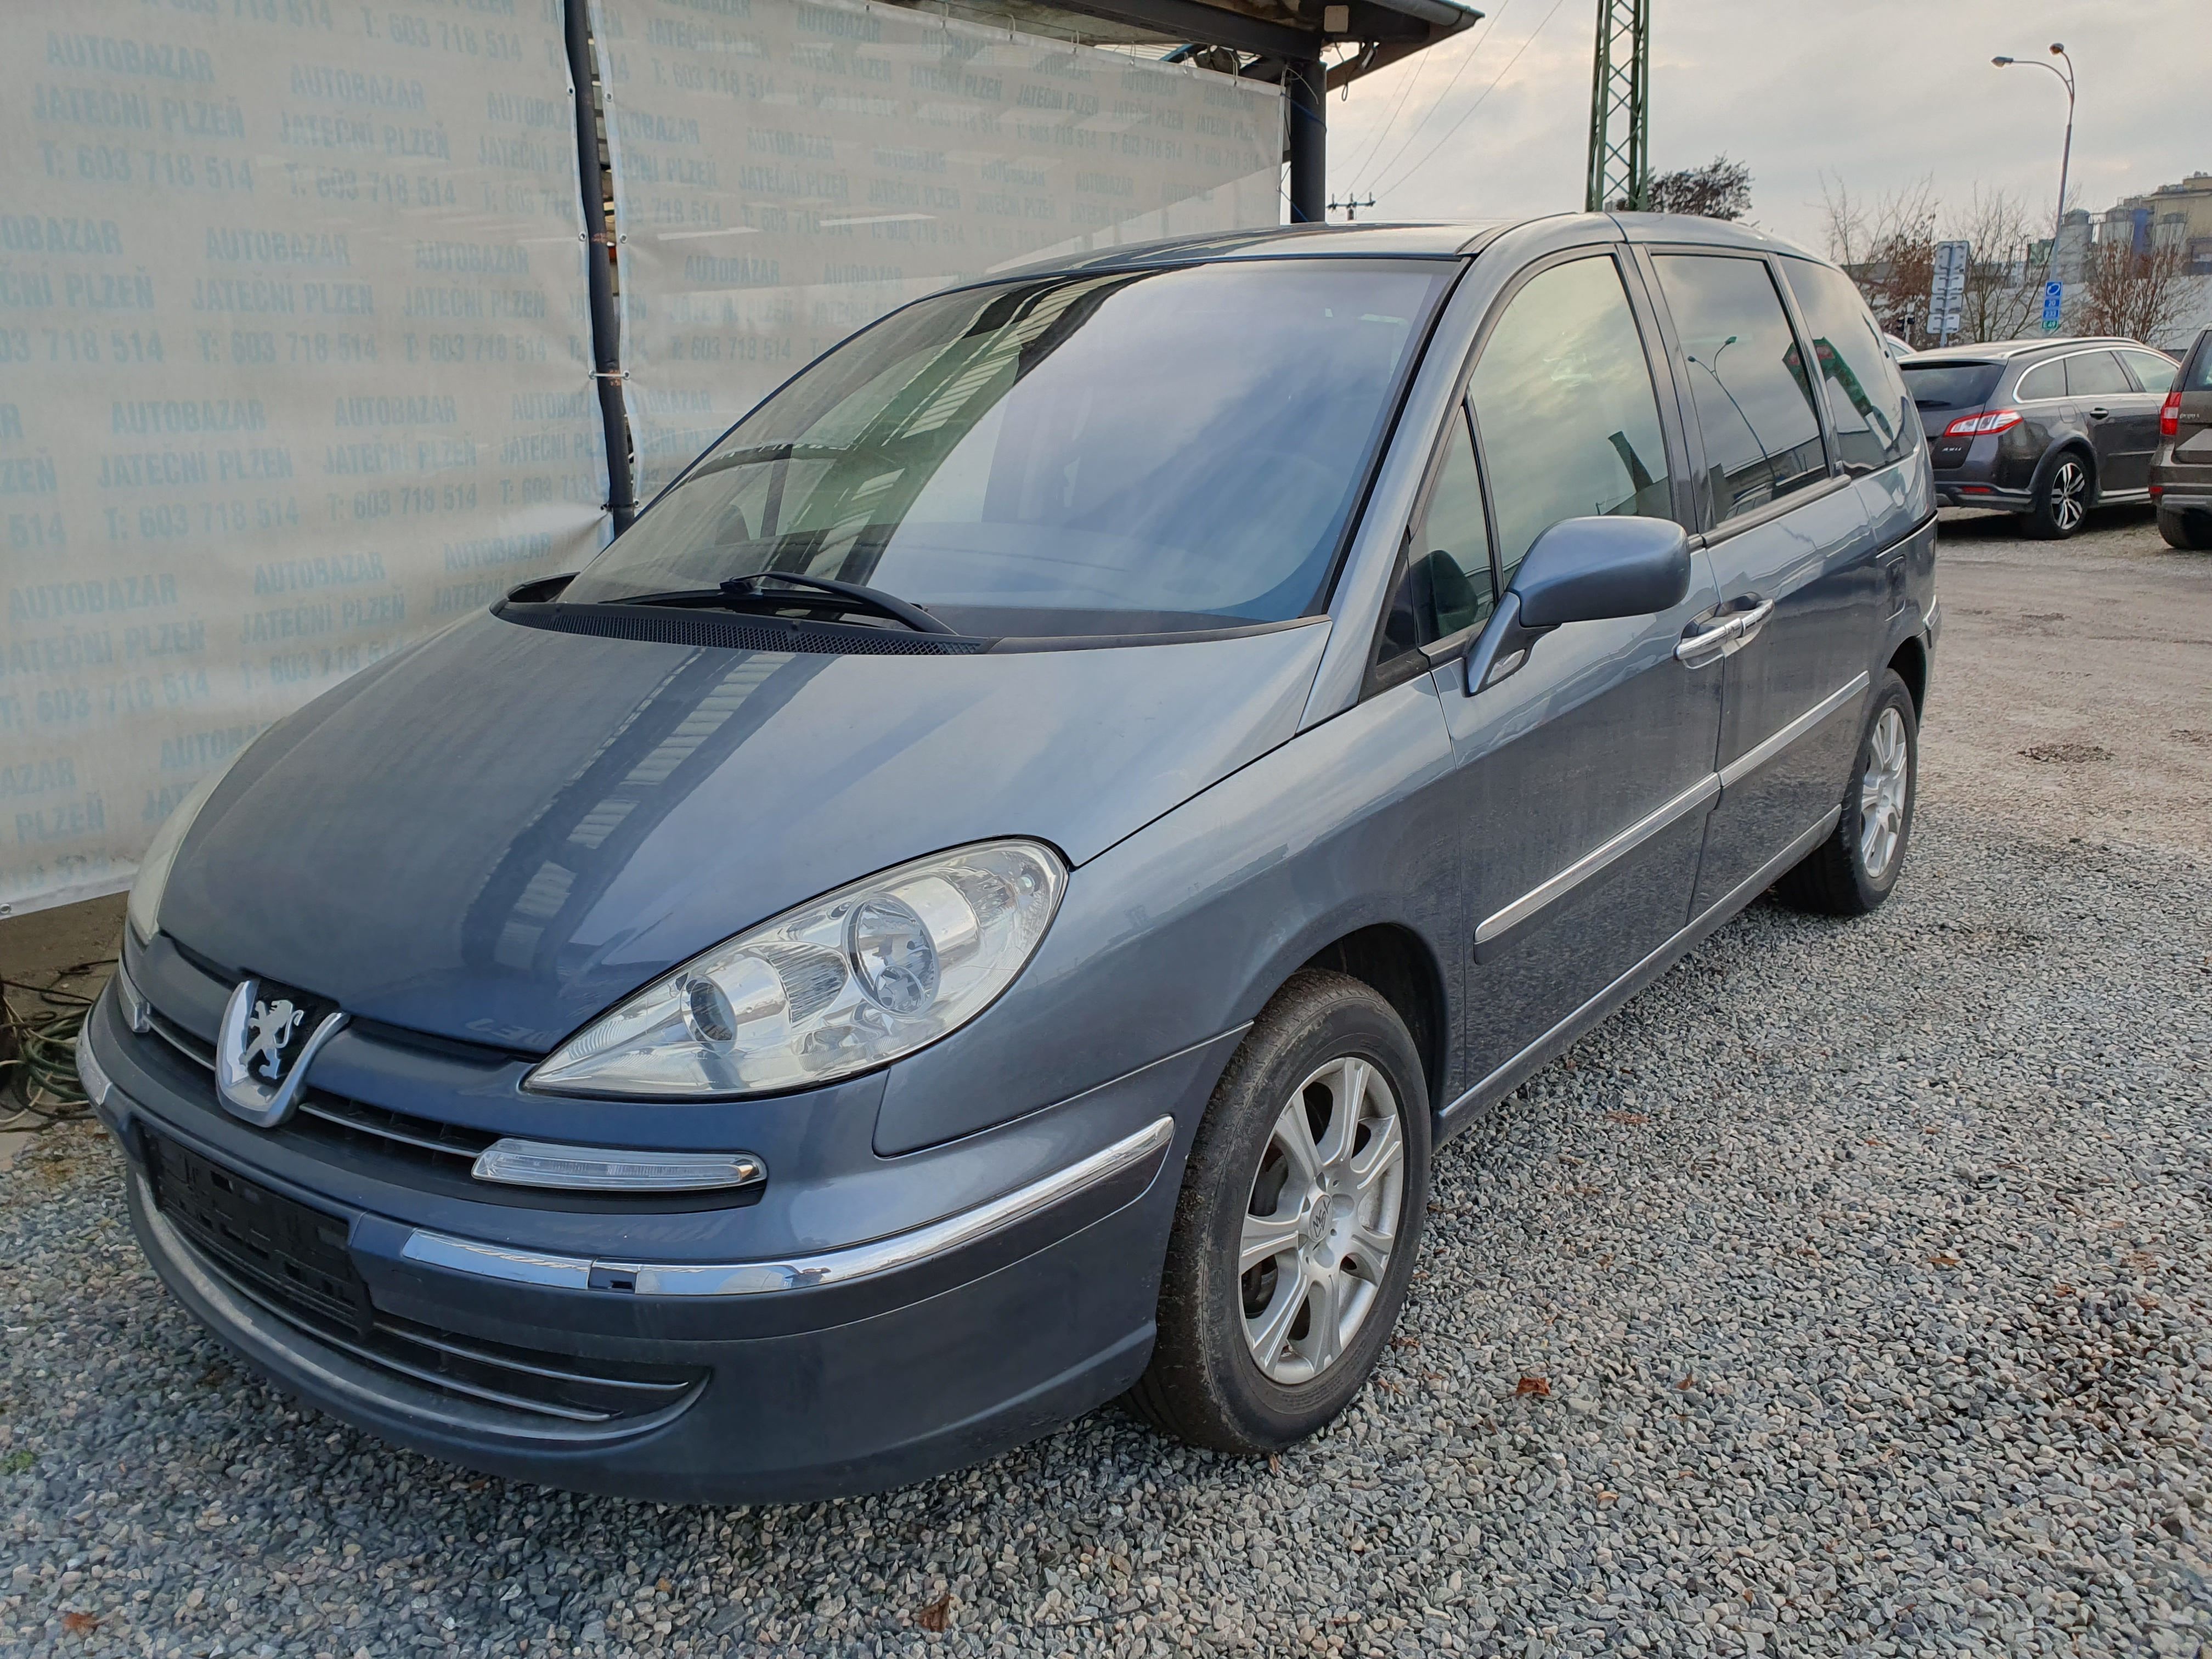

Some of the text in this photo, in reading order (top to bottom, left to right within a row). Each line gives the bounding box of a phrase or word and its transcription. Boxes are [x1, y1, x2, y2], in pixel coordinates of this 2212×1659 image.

[388, 13, 430, 48] 603
[437, 20, 477, 55] 718
[486, 30, 522, 62] 514
[47, 31, 215, 83] AUTOBAZAR
[291, 64, 426, 110] AUTOBAZAR
[622, 111, 700, 144] TOBAZAR
[76, 144, 131, 182] 603
[142, 149, 195, 188] 718
[205, 155, 254, 193] 514
[368, 171, 408, 206] 718
[417, 175, 456, 206] 514
[205, 226, 351, 267] AUTOBAZAR
[415, 239, 530, 274] AUTOBAZAR
[684, 255, 781, 284] AUTOBAZAR
[41, 328, 100, 363] 718
[111, 329, 164, 363] 514
[230, 330, 275, 364] 603
[285, 332, 329, 363] 718
[336, 332, 378, 362] 514
[429, 334, 465, 361] 603
[474, 334, 508, 360] 718
[691, 337, 721, 360] 603
[729, 336, 757, 360] 718
[112, 398, 267, 433] AUTOBAZAR
[335, 394, 458, 426] AUTOBAZAR
[138, 503, 189, 540] 603
[199, 499, 247, 533] 718
[255, 496, 300, 529] 514
[353, 489, 391, 520] 603
[399, 486, 436, 516] 718
[443, 483, 477, 511] 514
[8, 511, 66, 549] 514
[443, 531, 553, 572] AUTOBAZAR
[254, 551, 385, 596] AUTOBAZAR
[9, 573, 178, 624] AUTOBAZAR
[36, 686, 91, 724] 603
[103, 676, 154, 712] 718
[161, 667, 211, 704] 514
